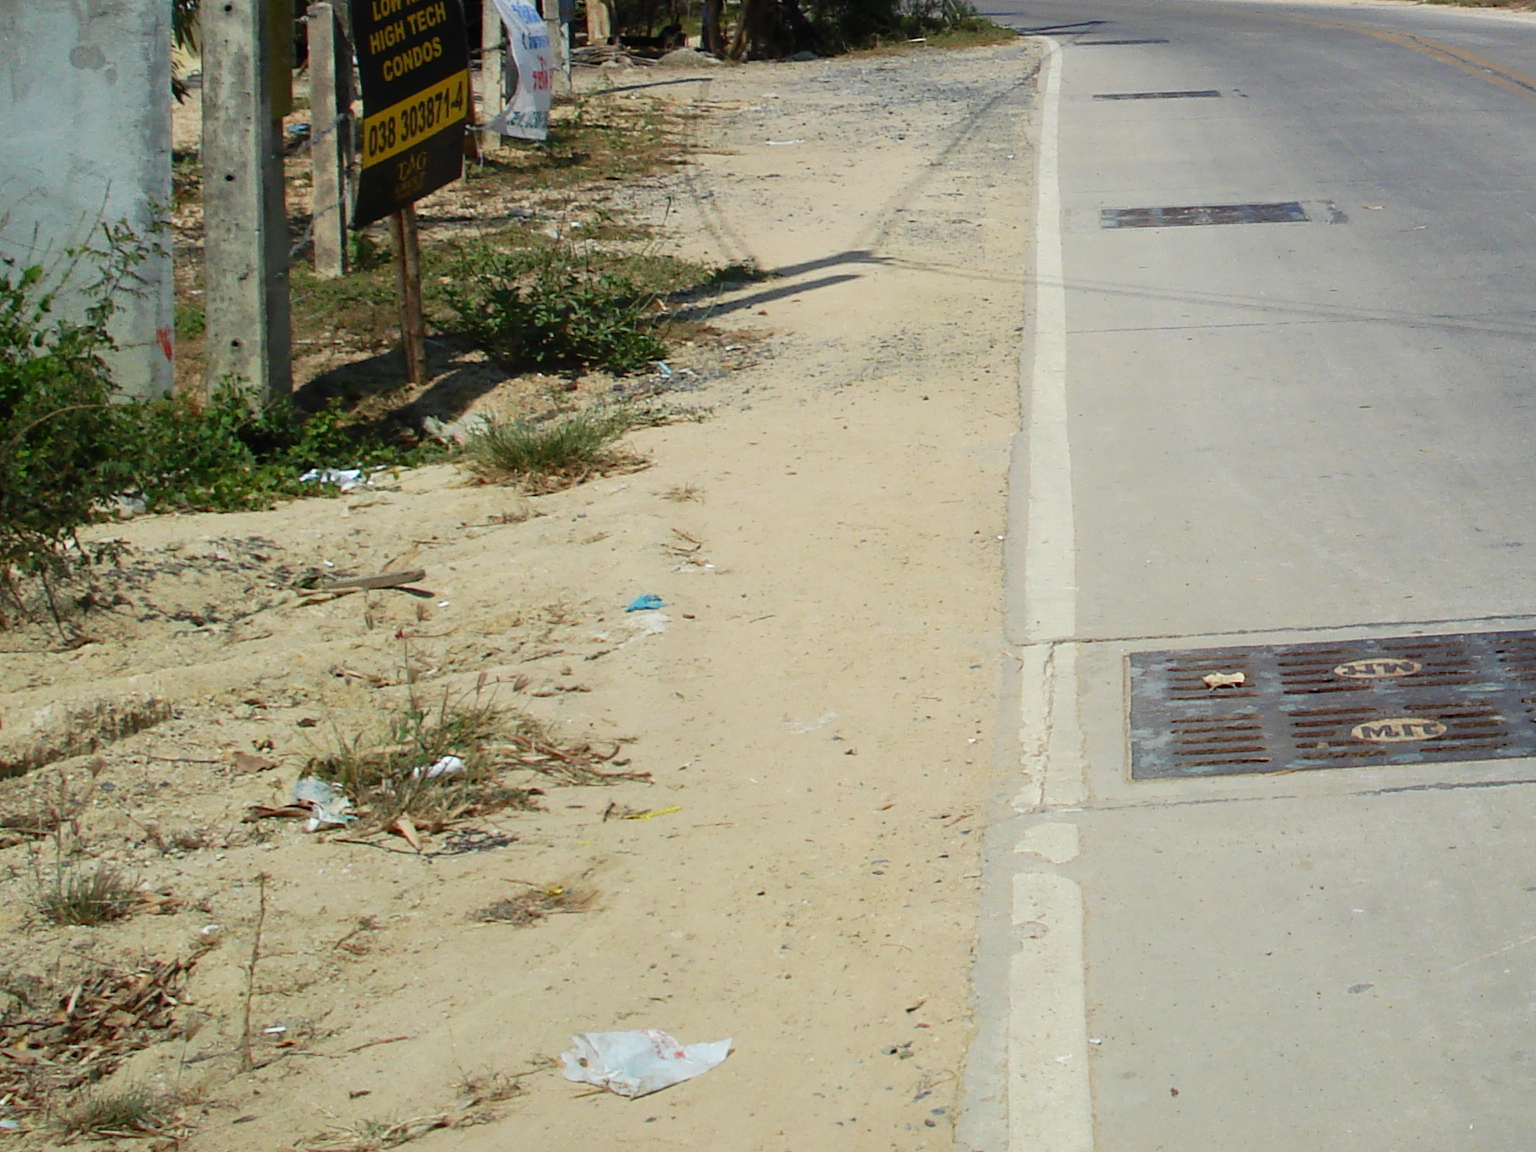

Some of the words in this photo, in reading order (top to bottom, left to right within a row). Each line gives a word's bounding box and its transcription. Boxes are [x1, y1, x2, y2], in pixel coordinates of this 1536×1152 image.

[369, 20, 406, 55] HIGH
[407, 1, 447, 35] TECH
[382, 36, 443, 82] CONDOS
[368, 116, 396, 157] 038
[401, 81, 463, 142] 303871-4
